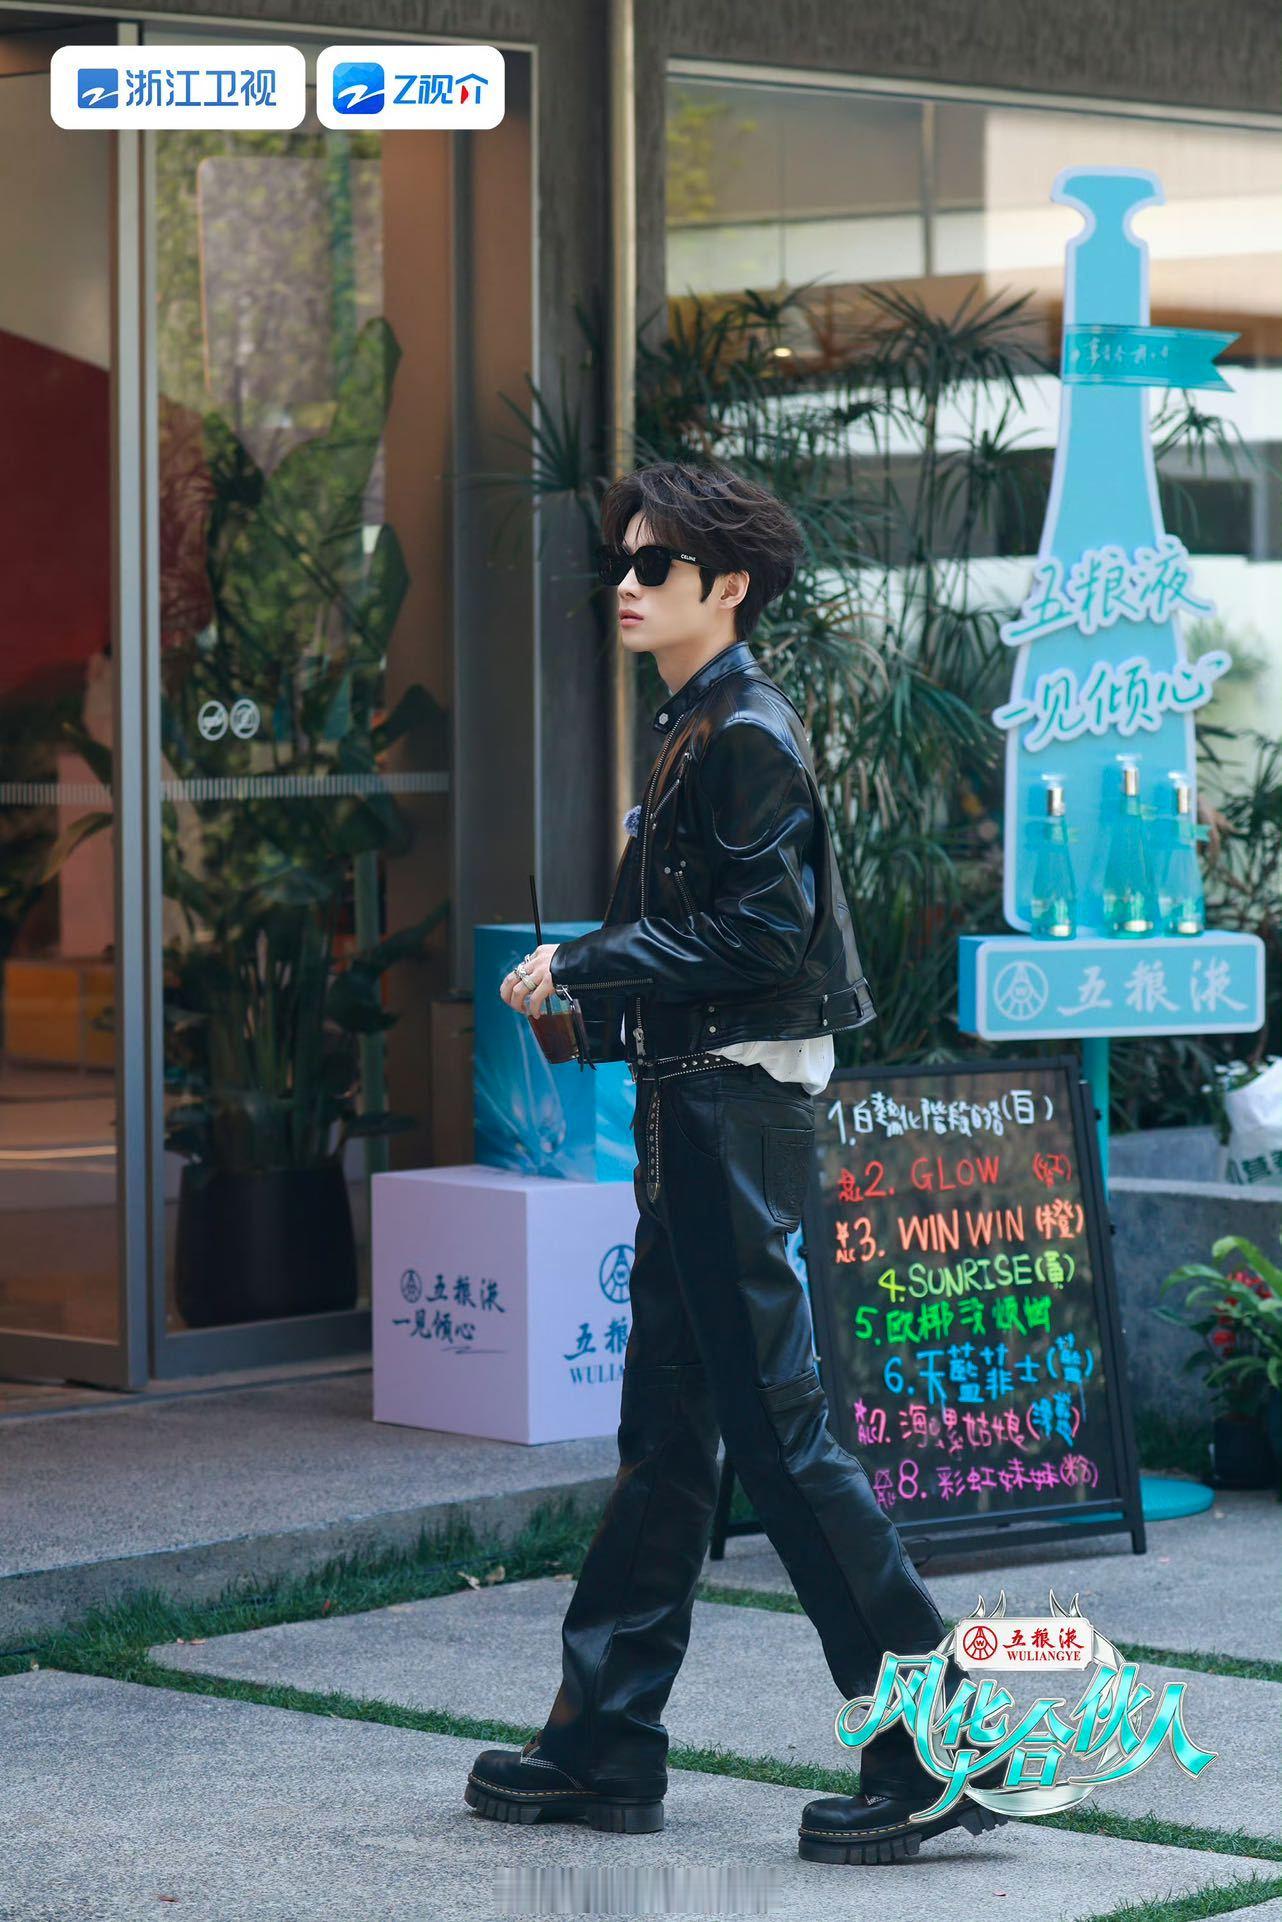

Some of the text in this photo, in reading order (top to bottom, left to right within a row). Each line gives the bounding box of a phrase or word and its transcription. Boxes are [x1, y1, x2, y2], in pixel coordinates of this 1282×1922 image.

[680, 554, 696, 562] CELINE
[1008, 541, 1213, 639] 五粮液
[1001, 656, 1226, 746] 一见倾心
[1057, 956, 1248, 1016] 五粮液
[911, 1156, 1000, 1192] GLOW
[898, 1208, 960, 1253] WIN
[965, 1206, 1025, 1248] WIN
[426, 1273, 505, 1313] 五粮液
